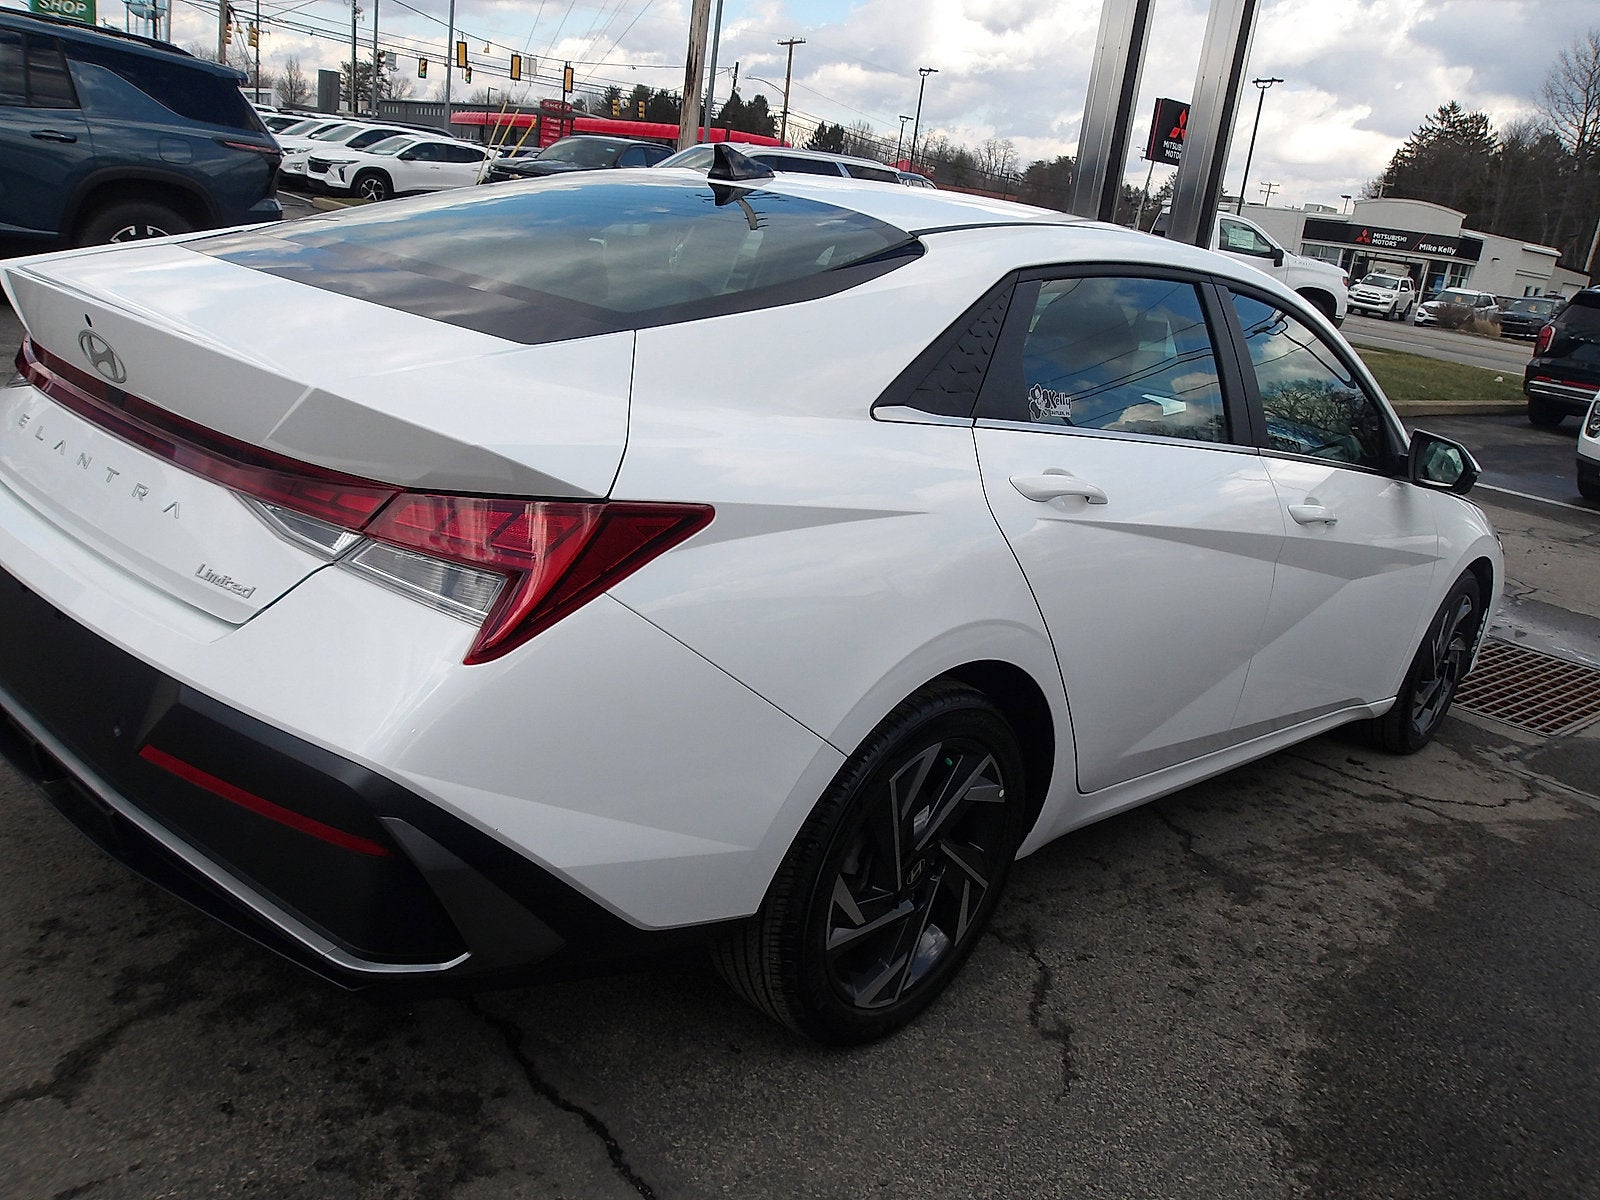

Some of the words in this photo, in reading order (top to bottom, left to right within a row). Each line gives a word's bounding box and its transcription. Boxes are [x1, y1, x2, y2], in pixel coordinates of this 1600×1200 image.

[38, 0, 87, 15] SHOP
[1372, 238, 1397, 247] MOTORS
[1373, 232, 1408, 242] MITSUBISHI
[1419, 243, 1437, 252] Mike
[1438, 245, 1456, 255] Kelly
[1048, 391, 1071, 409] Kelly
[17, 413, 181, 520] ELANTRA
[195, 563, 257, 599] Limited
